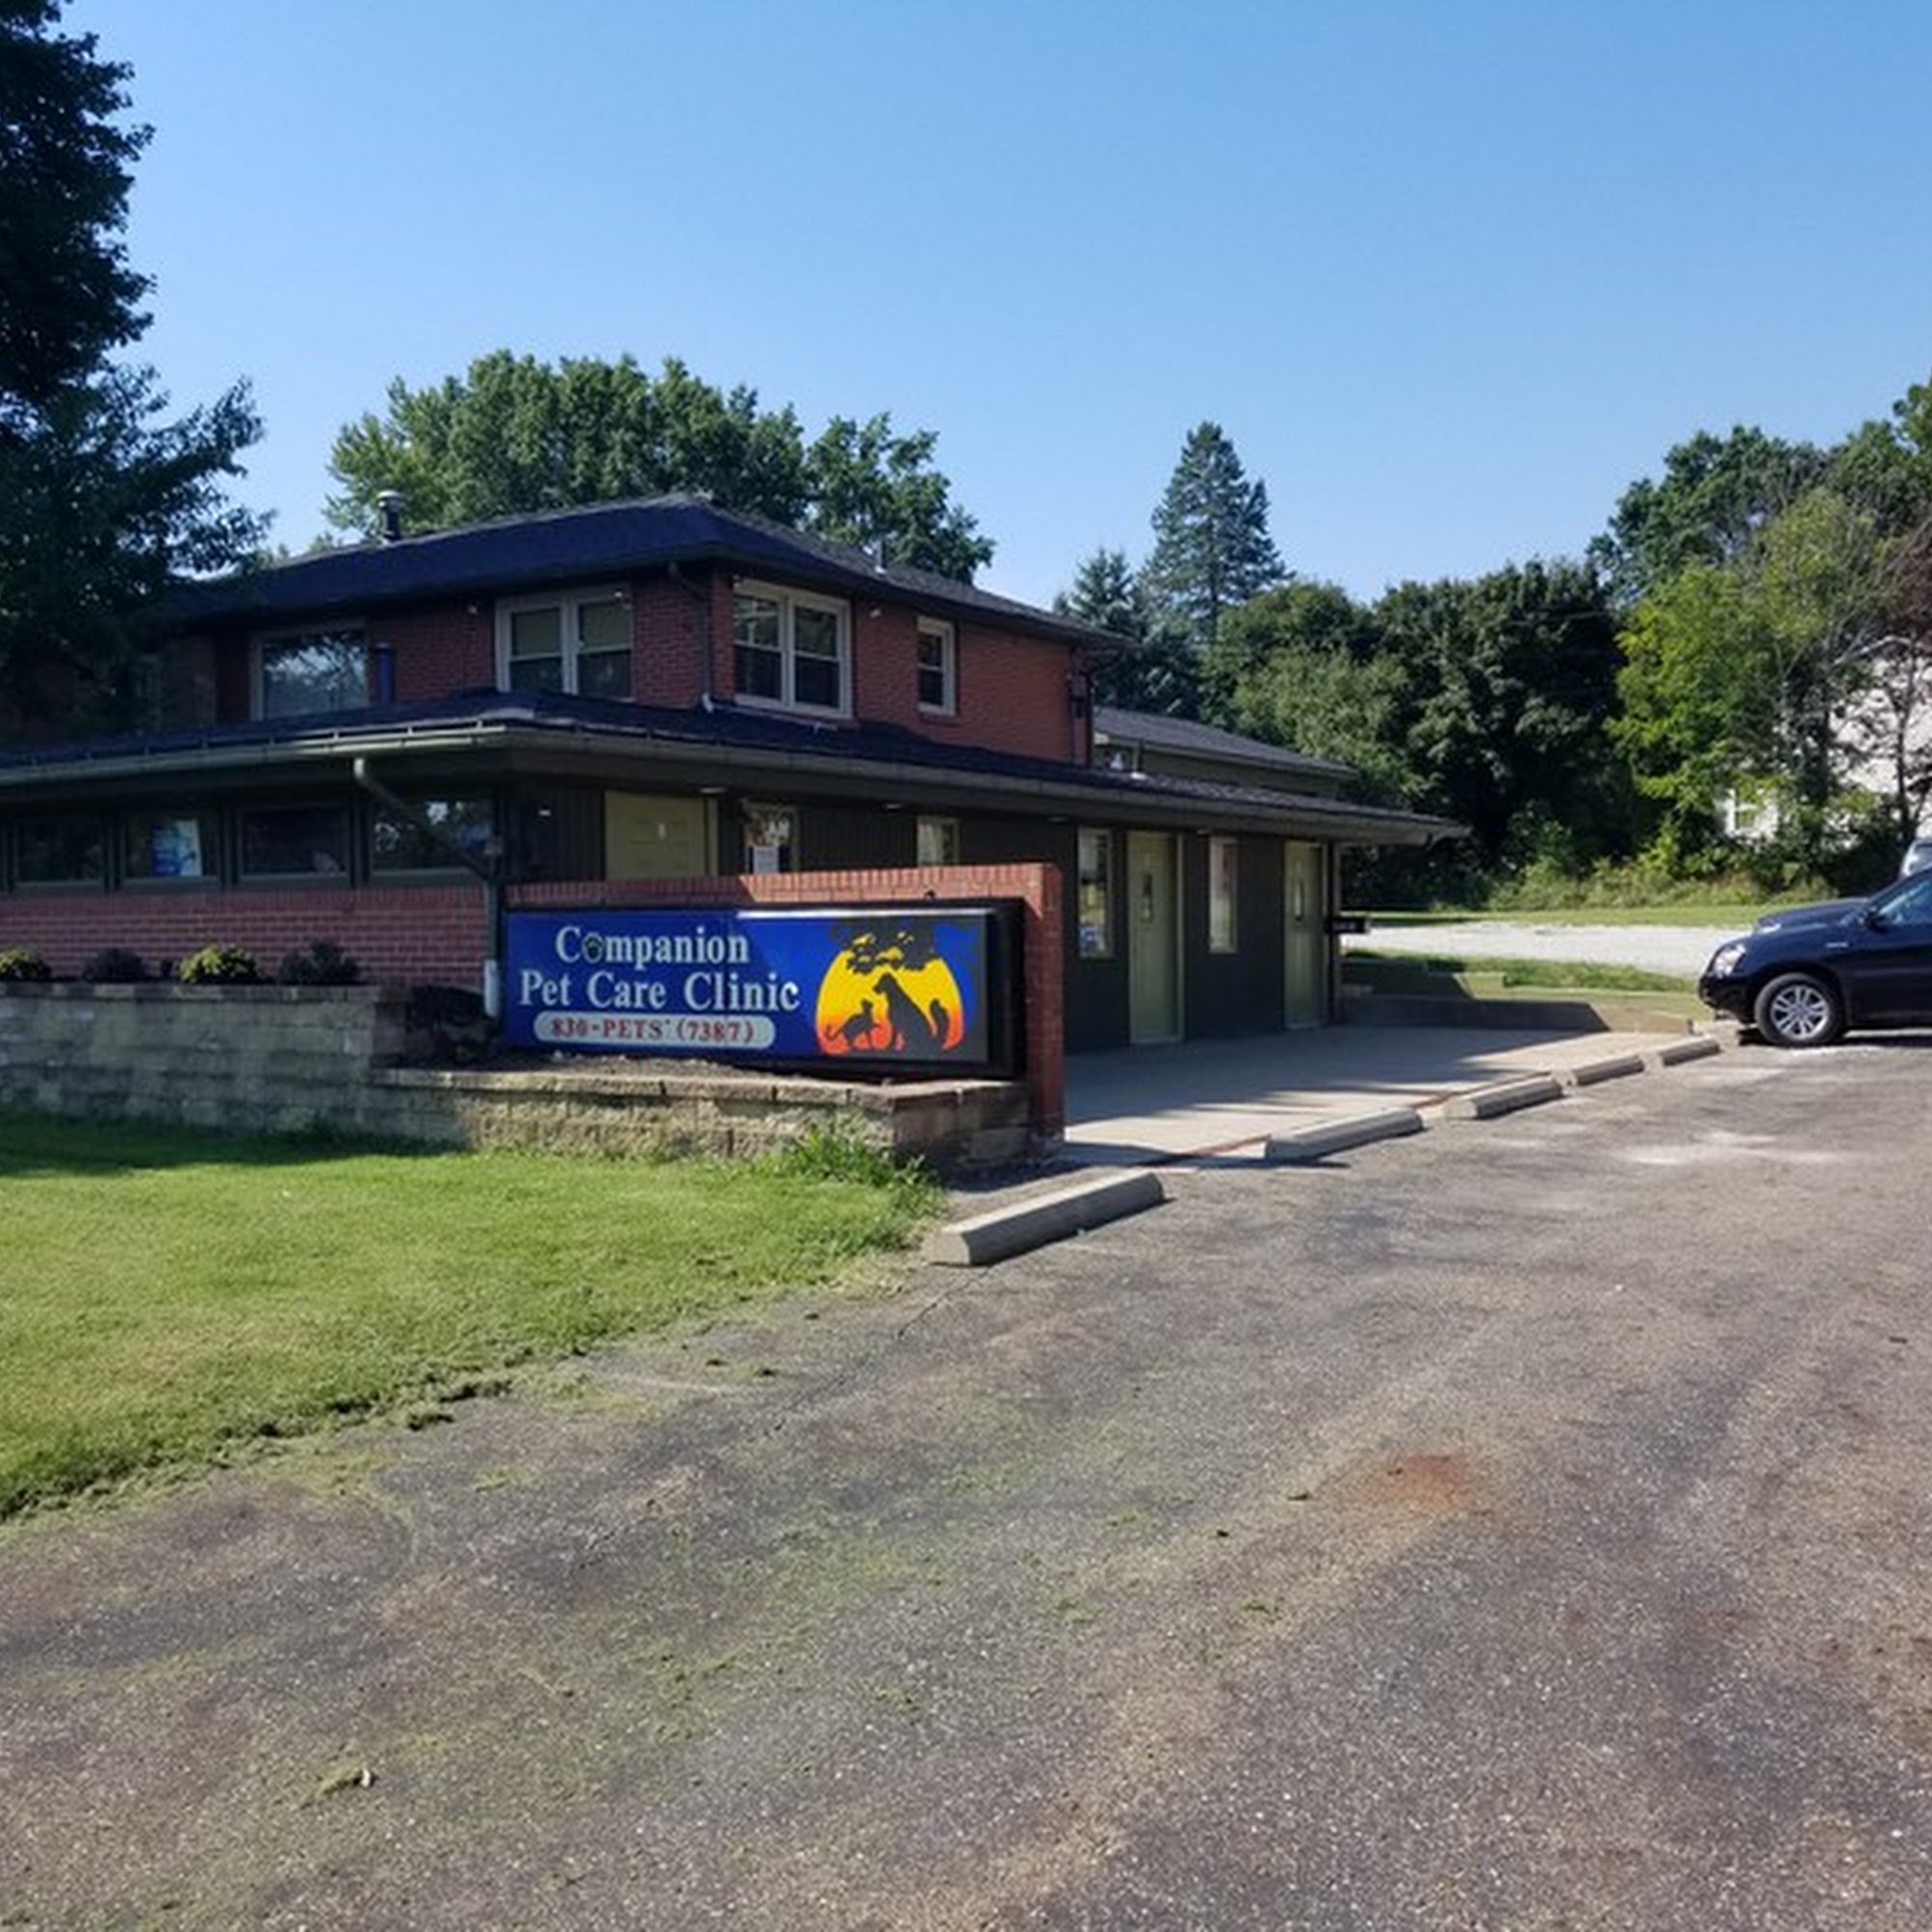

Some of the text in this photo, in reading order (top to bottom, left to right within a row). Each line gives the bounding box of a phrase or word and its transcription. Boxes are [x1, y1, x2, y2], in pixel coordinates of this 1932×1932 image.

[554, 924, 750, 971] Companion
[519, 969, 801, 1011] Pet Care Clinic
[677, 1017, 754, 1043] (7387)
